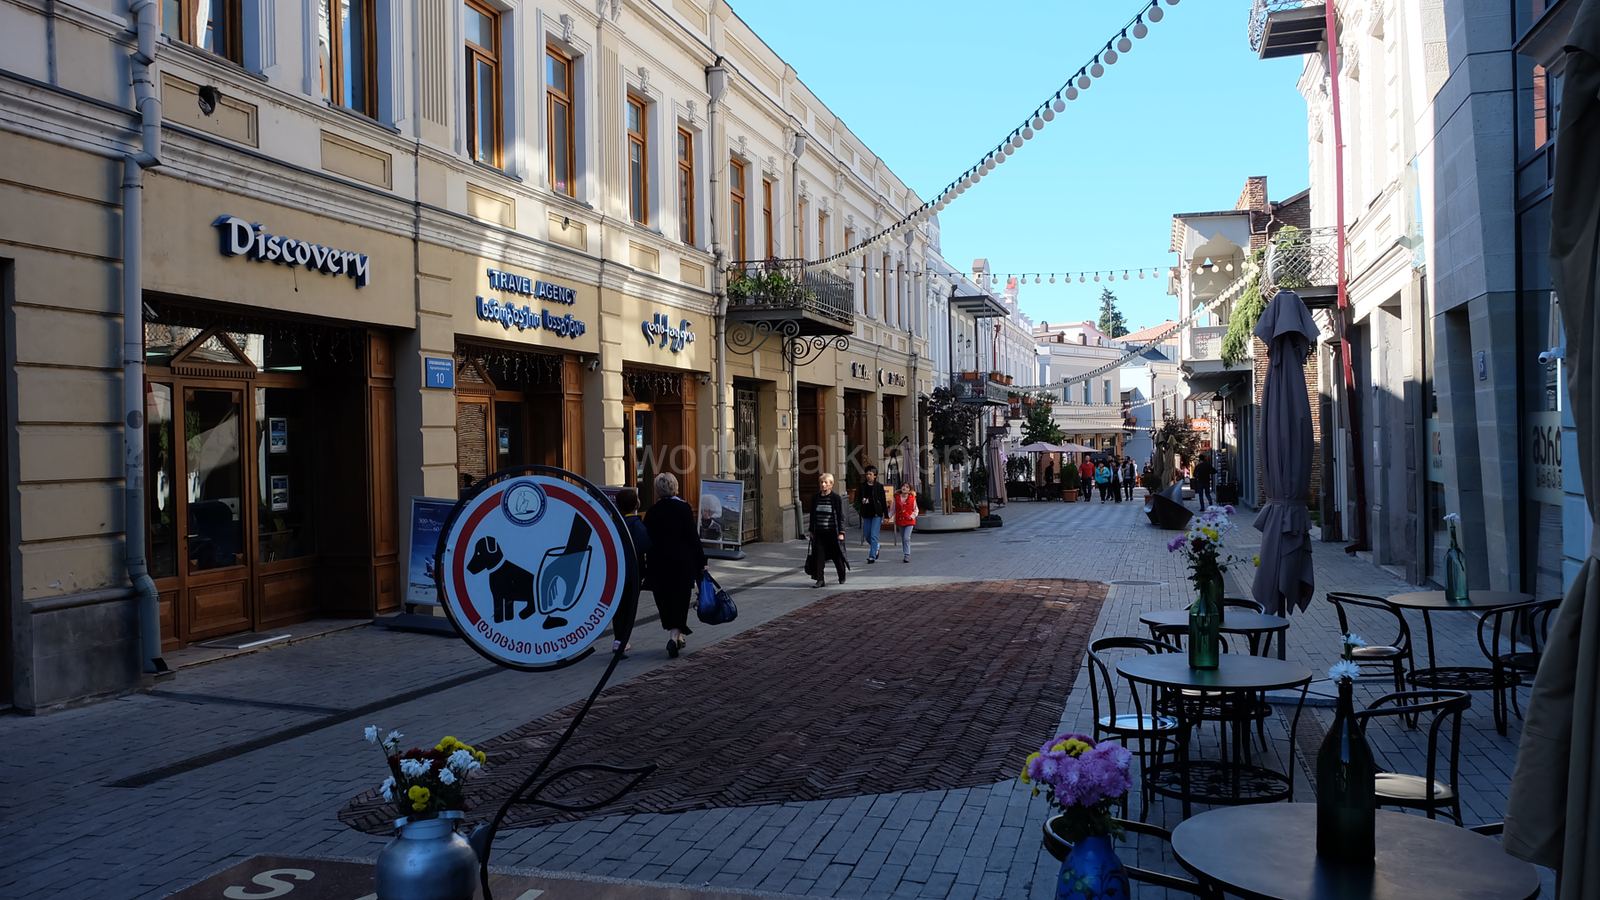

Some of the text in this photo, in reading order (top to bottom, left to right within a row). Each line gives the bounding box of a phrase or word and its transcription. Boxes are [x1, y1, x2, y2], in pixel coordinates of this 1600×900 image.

[215, 215, 370, 288] Discovery
[489, 269, 577, 304] TRAVEL AGENCY
[435, 372, 446, 385] 10
[477, 603, 610, 654] დაიცავი სისუფთავე!
